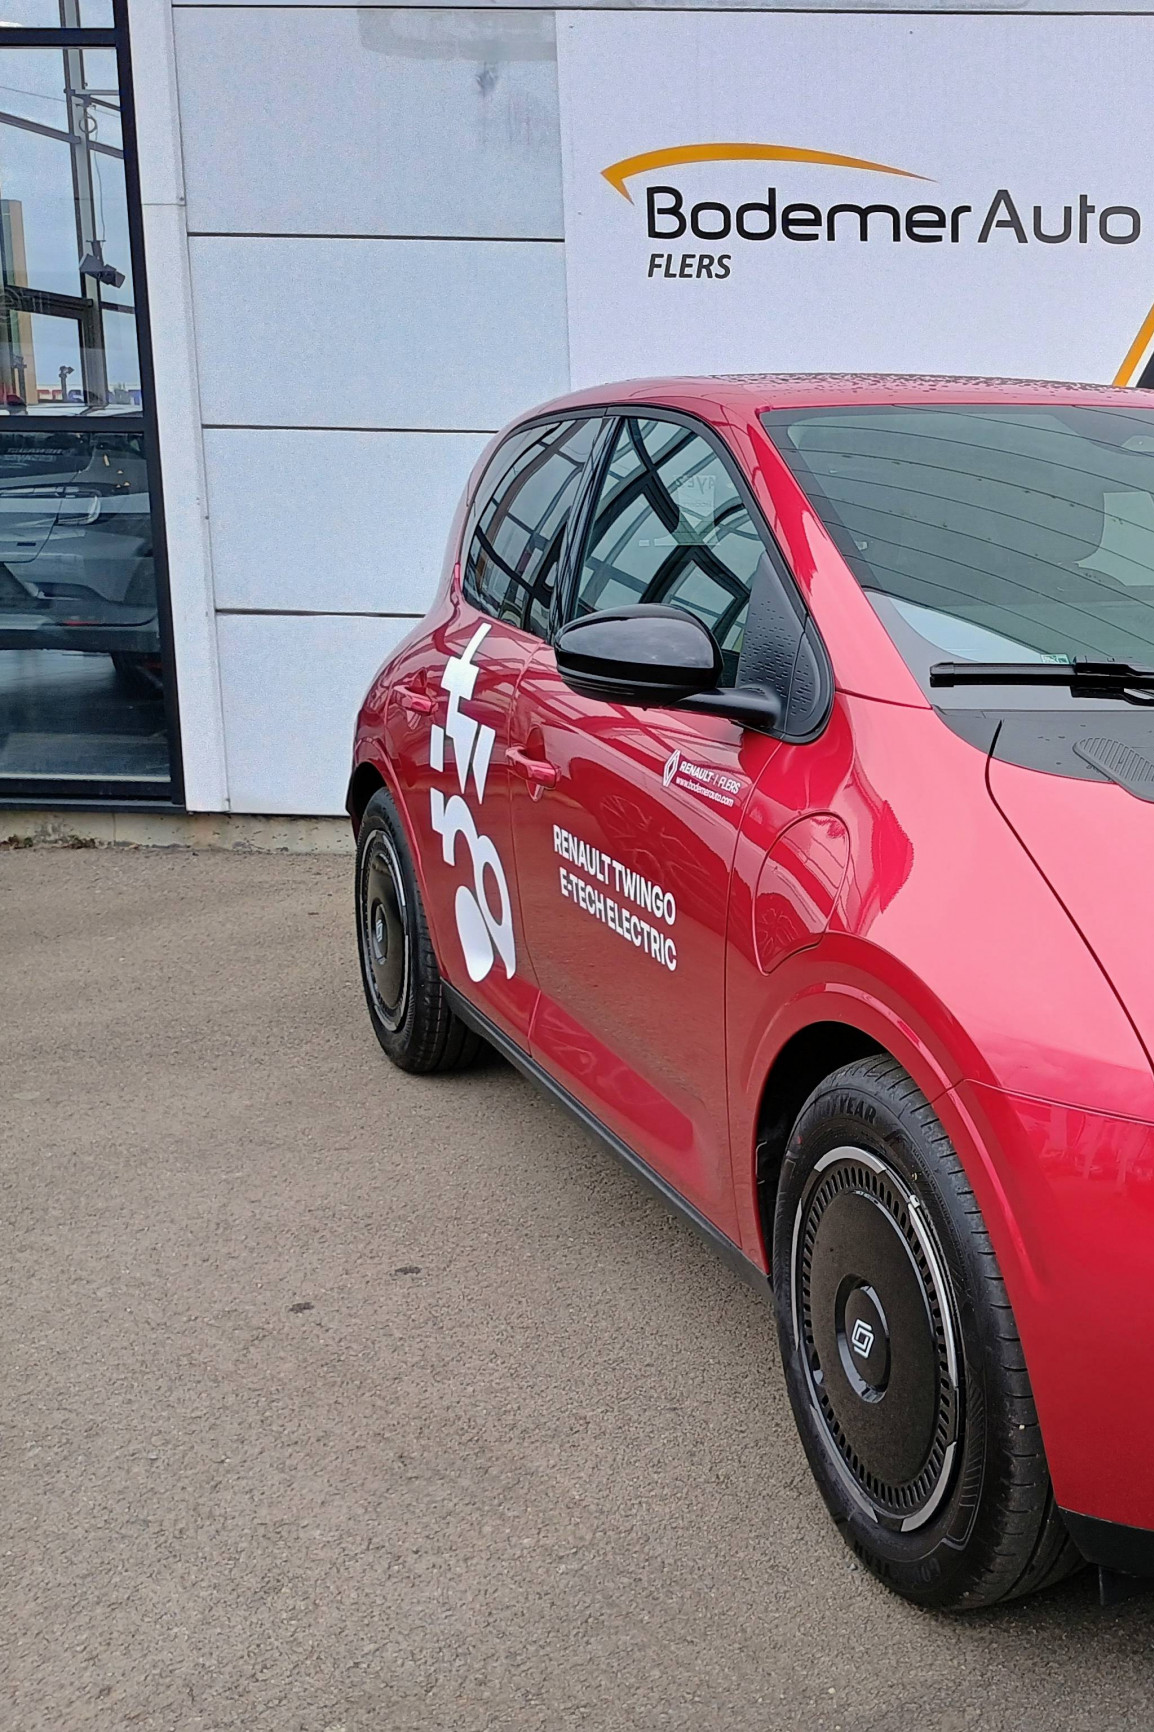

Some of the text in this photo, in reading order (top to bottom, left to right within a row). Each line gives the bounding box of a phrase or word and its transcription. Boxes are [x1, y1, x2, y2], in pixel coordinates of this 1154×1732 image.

[647, 253, 732, 280] FLERS
[680, 762, 741, 793] RENAULT FLERS
[553, 824, 677, 926] RENAULT TWINGO
[559, 866, 678, 972] E-TECH ELECTRIC
